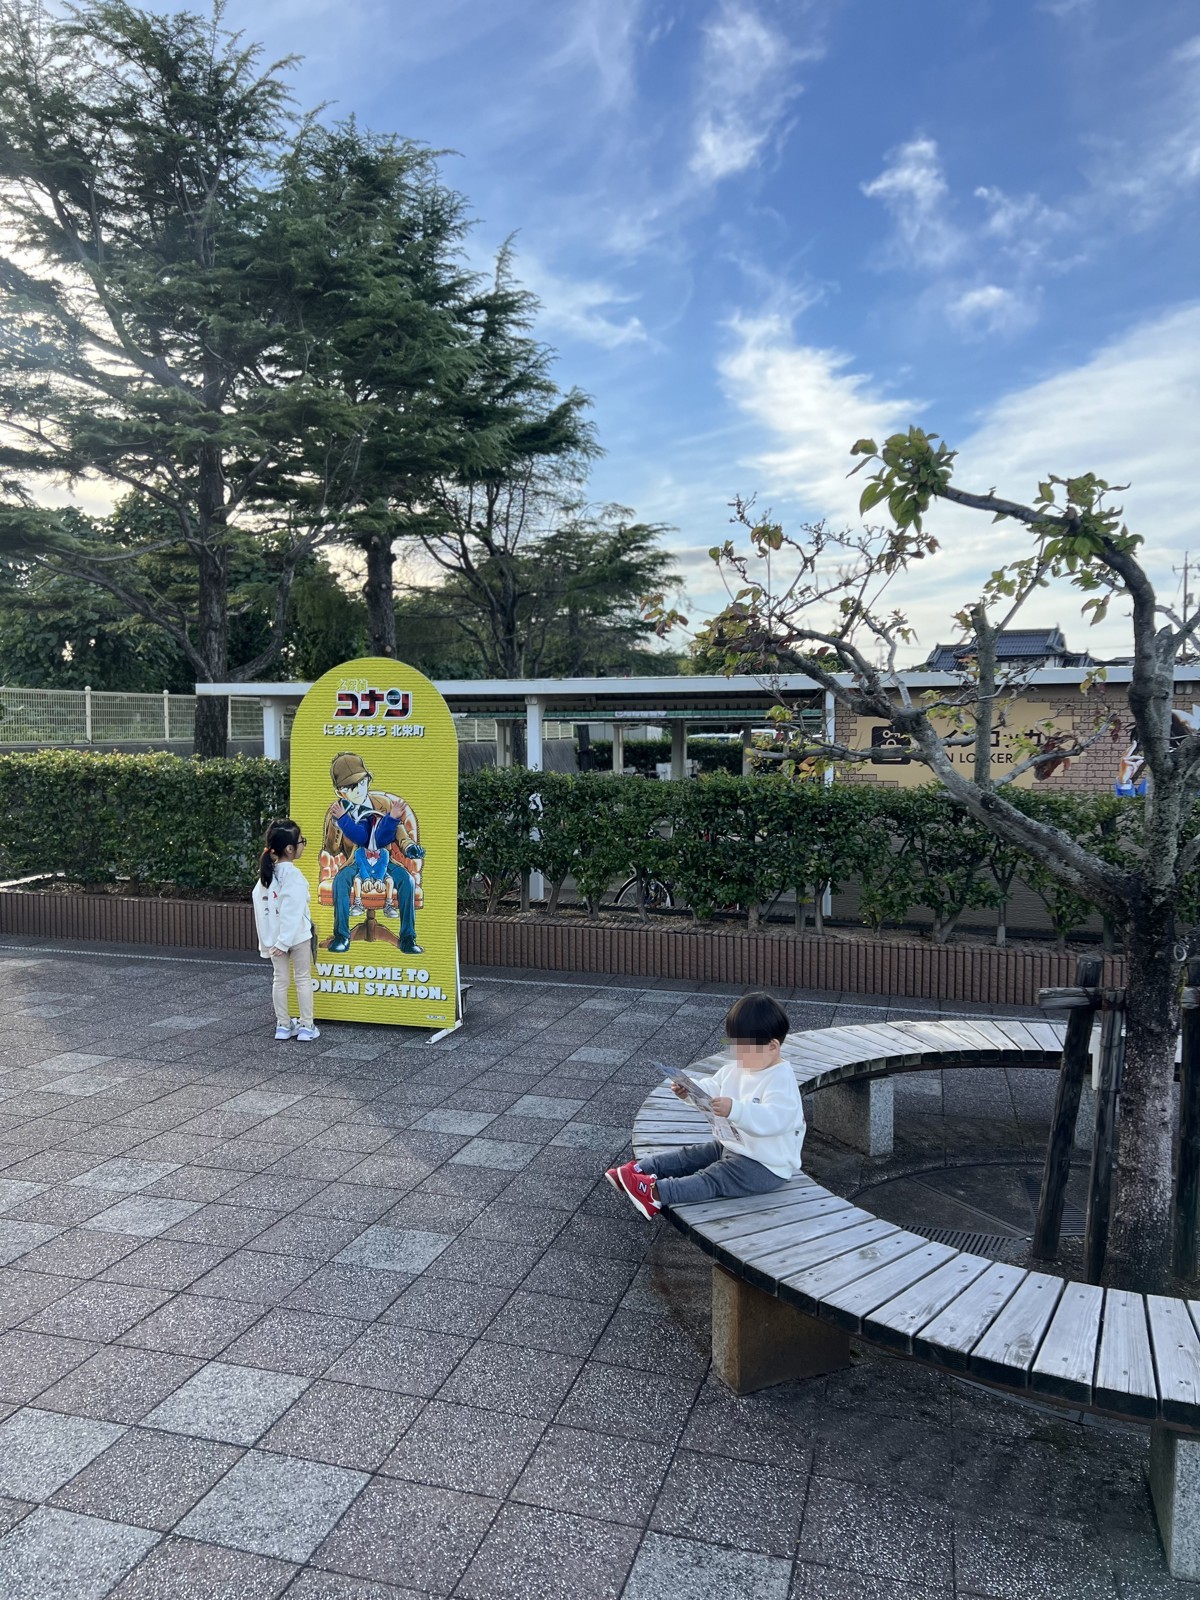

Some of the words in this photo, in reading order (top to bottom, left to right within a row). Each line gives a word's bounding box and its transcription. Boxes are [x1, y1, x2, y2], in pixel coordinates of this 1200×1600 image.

[334, 689, 412, 719] コナン
[323, 724, 387, 737] に会えるまち
[391, 724, 425, 737] 北栄町
[959, 752, 1013, 764] LOKER
[316, 963, 403, 981] WELCOME
[406, 968, 430, 983] TO
[311, 978, 360, 995] ONAN
[364, 982, 447, 1001] STATION.
[638, 1181, 648, 1193] N
